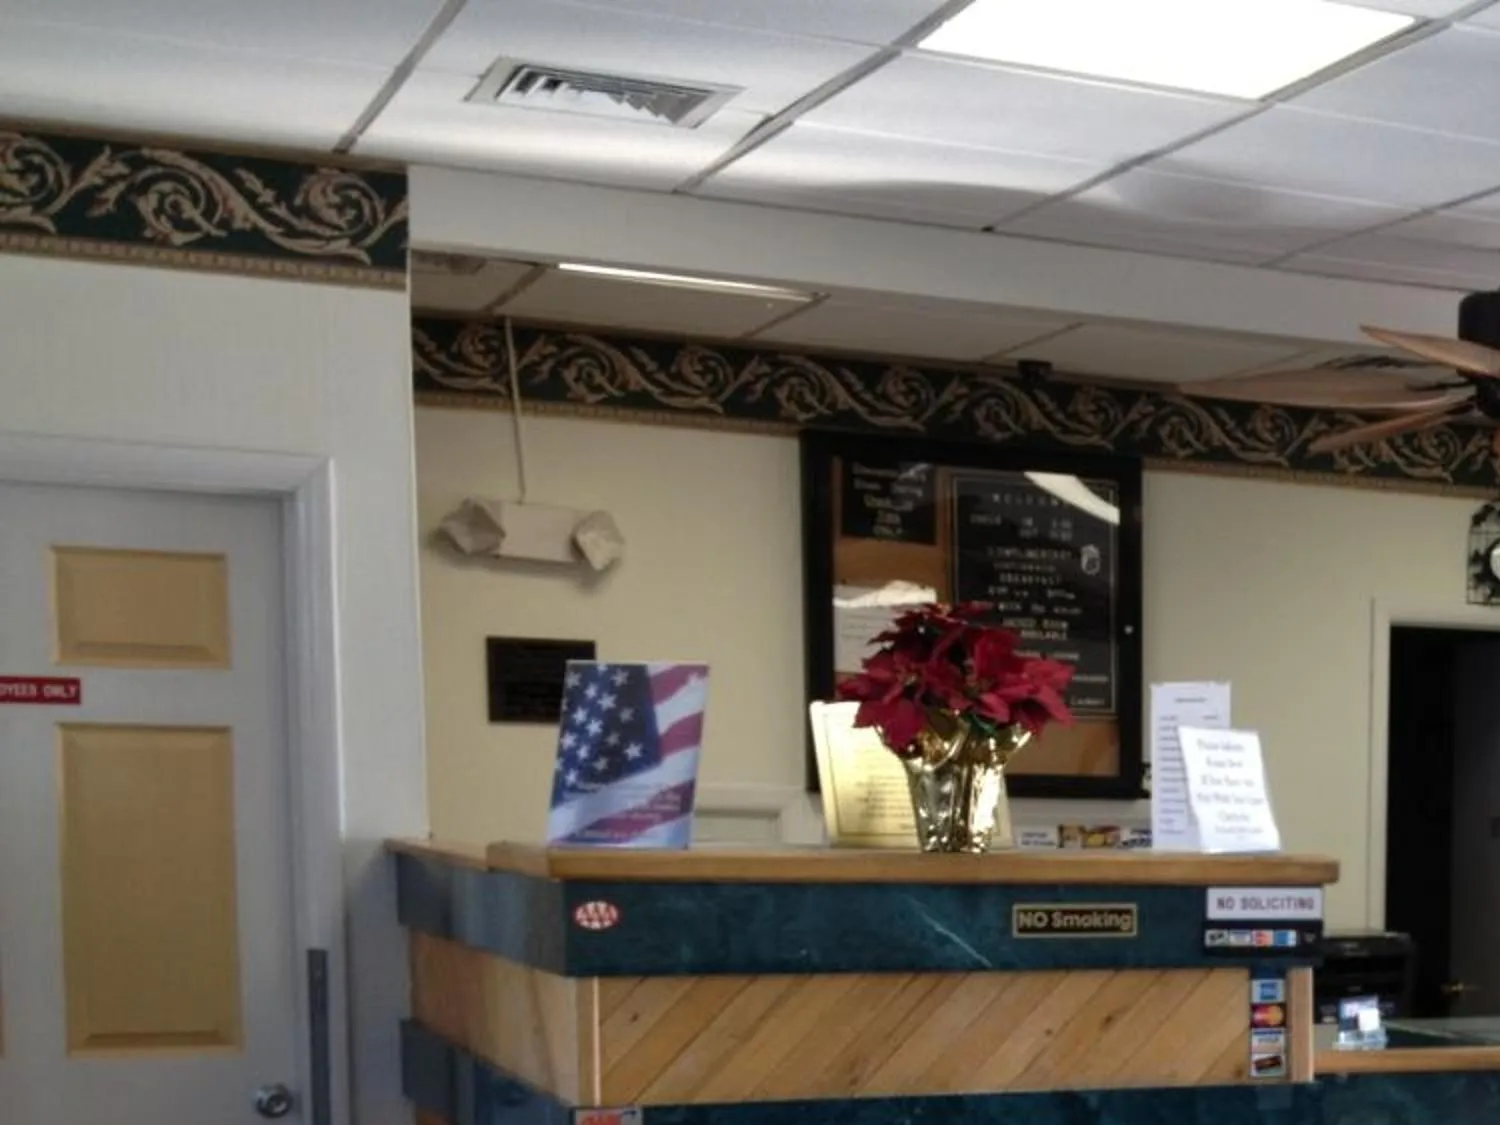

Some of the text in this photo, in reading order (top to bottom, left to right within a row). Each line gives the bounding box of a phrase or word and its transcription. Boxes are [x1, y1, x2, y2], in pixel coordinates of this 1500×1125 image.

[43, 683, 77, 699] ONLY
[1215, 896, 1315, 911] NO SOLICITING
[1018, 910, 1132, 931] NO Smoking
